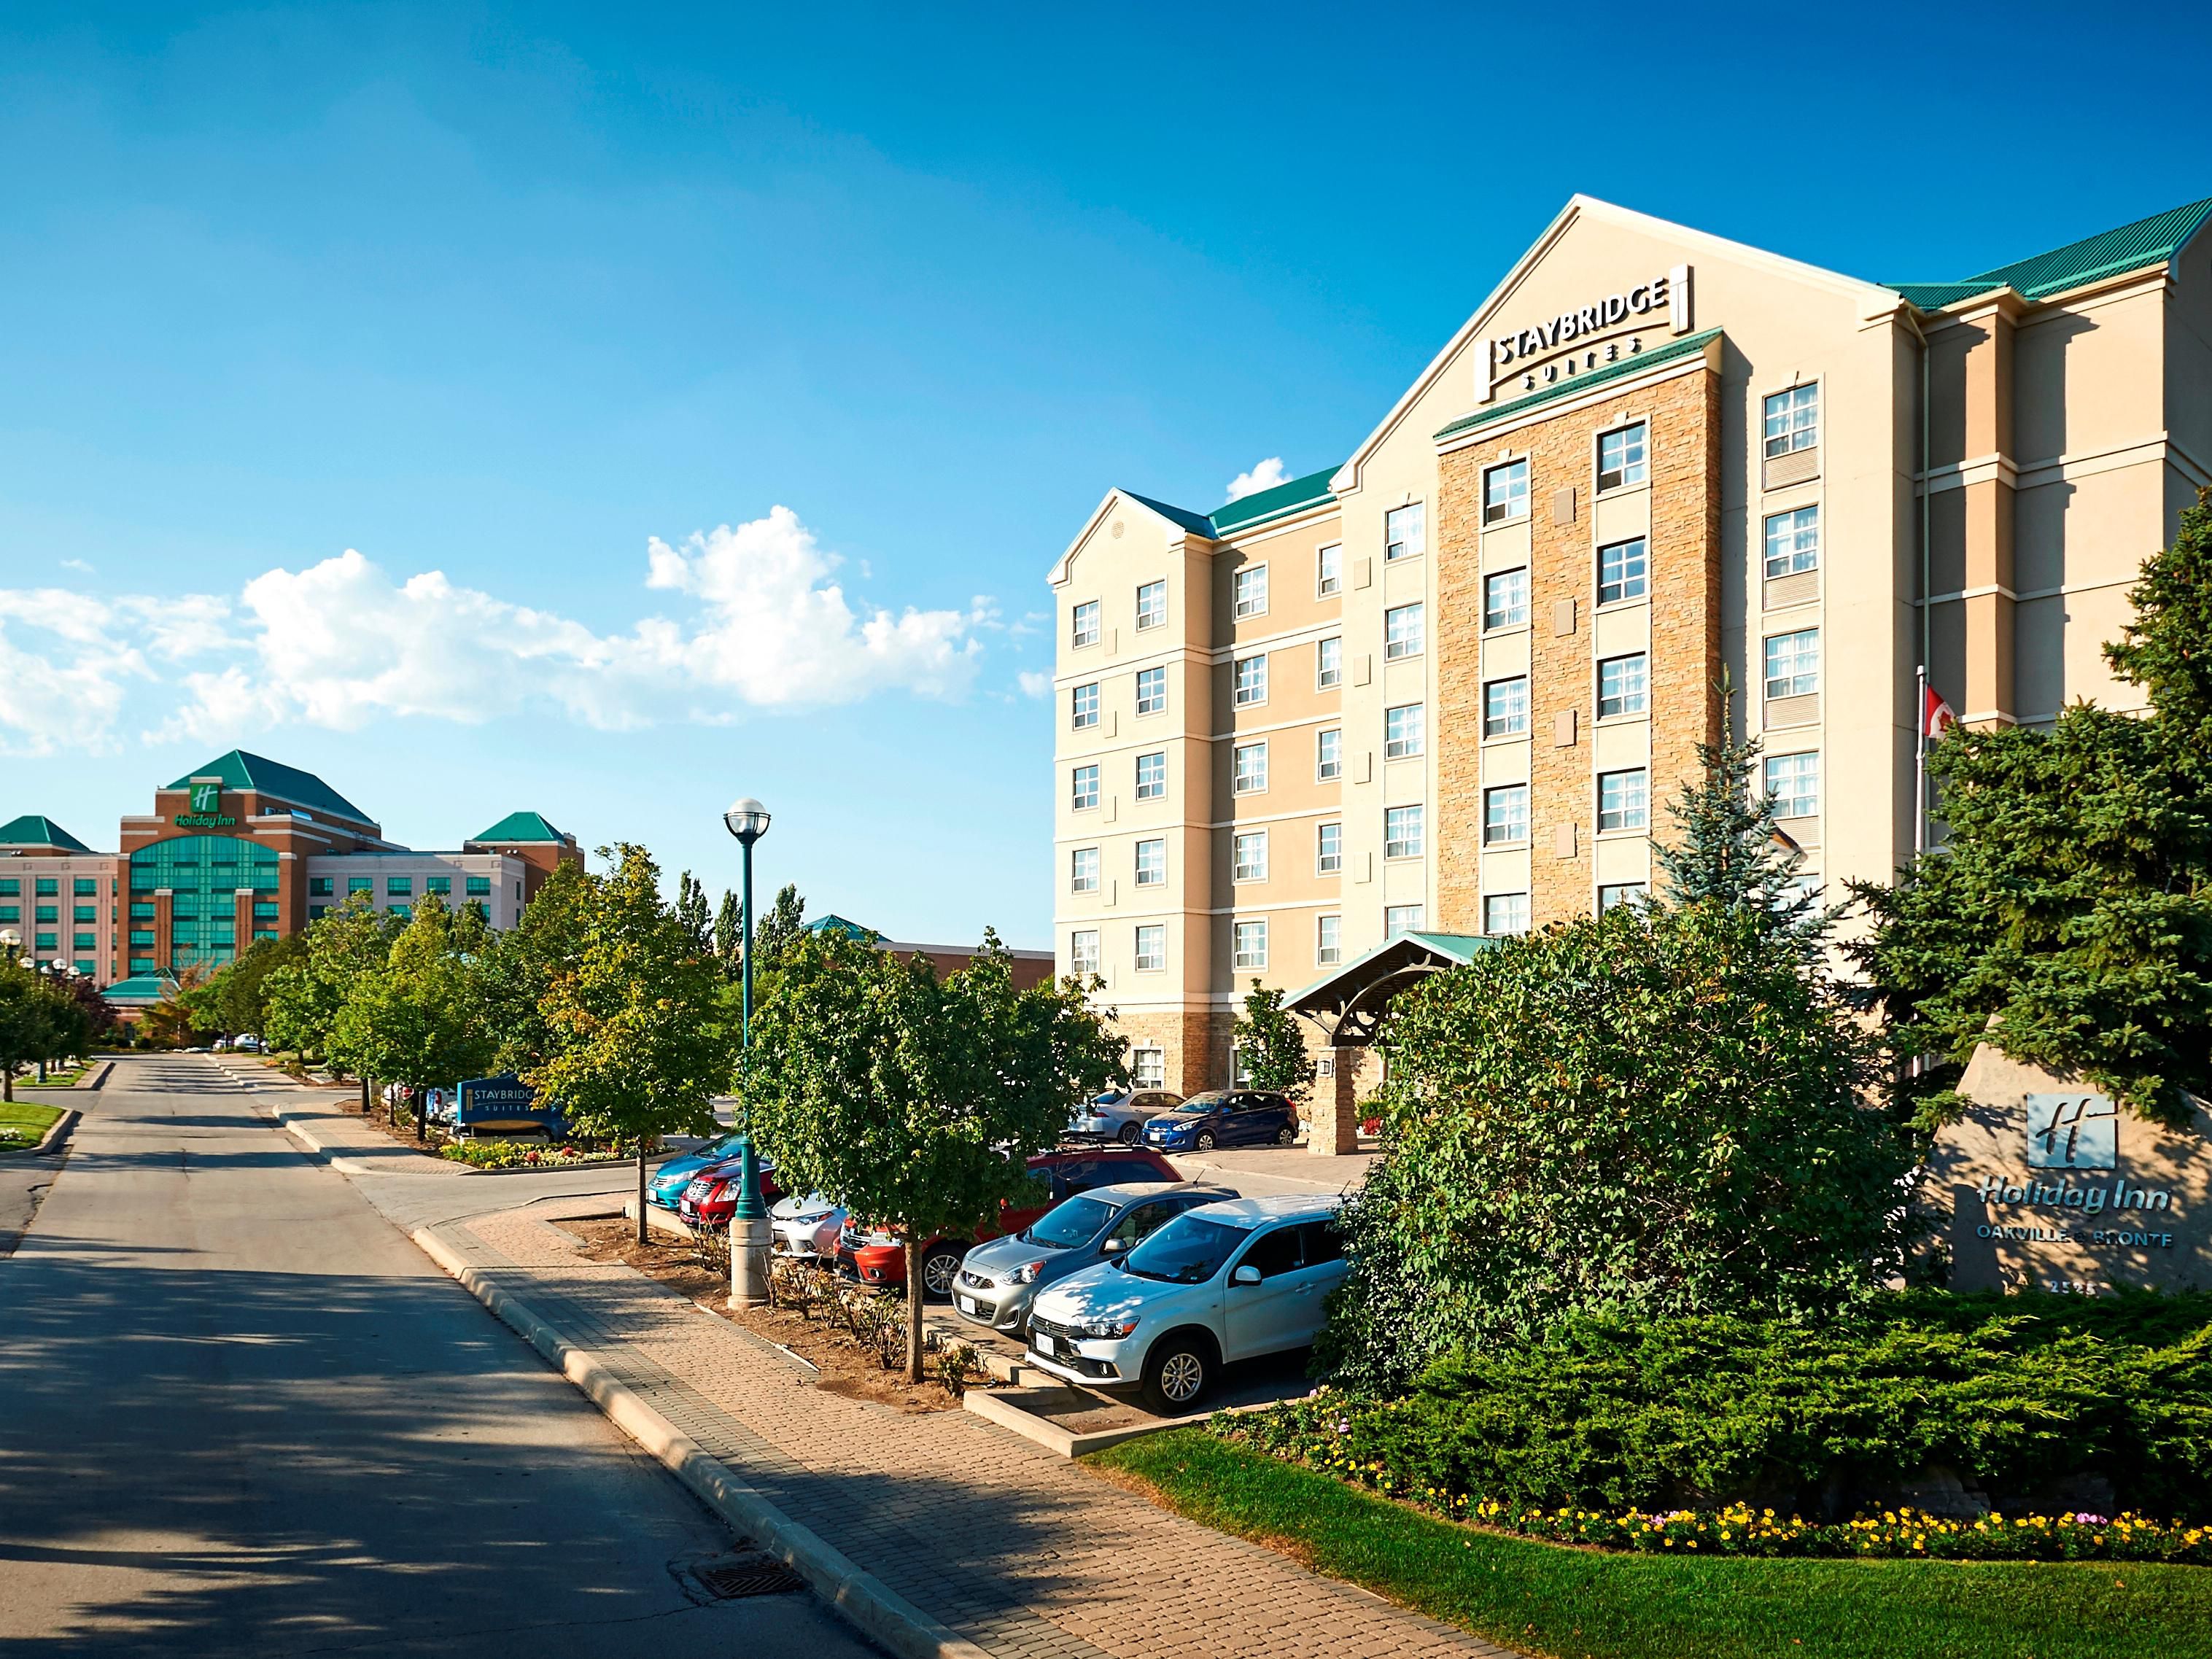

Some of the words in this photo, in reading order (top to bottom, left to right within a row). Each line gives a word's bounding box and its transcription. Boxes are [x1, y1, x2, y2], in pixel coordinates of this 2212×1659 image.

[1494, 276, 1667, 365] STAYBRIDGE
[1519, 335, 1641, 390] SUITES
[174, 813, 216, 828] Holiday
[217, 813, 236, 825] Inn
[474, 1089, 536, 1100] STAYBRIDG
[1976, 1175, 2108, 1214] Holiday
[2114, 1179, 2170, 1211] Inn
[1976, 1224, 2068, 1243] OAKVILLE
[2092, 1230, 2173, 1248] BRONTE
[2050, 1280, 2097, 1296] 2525
